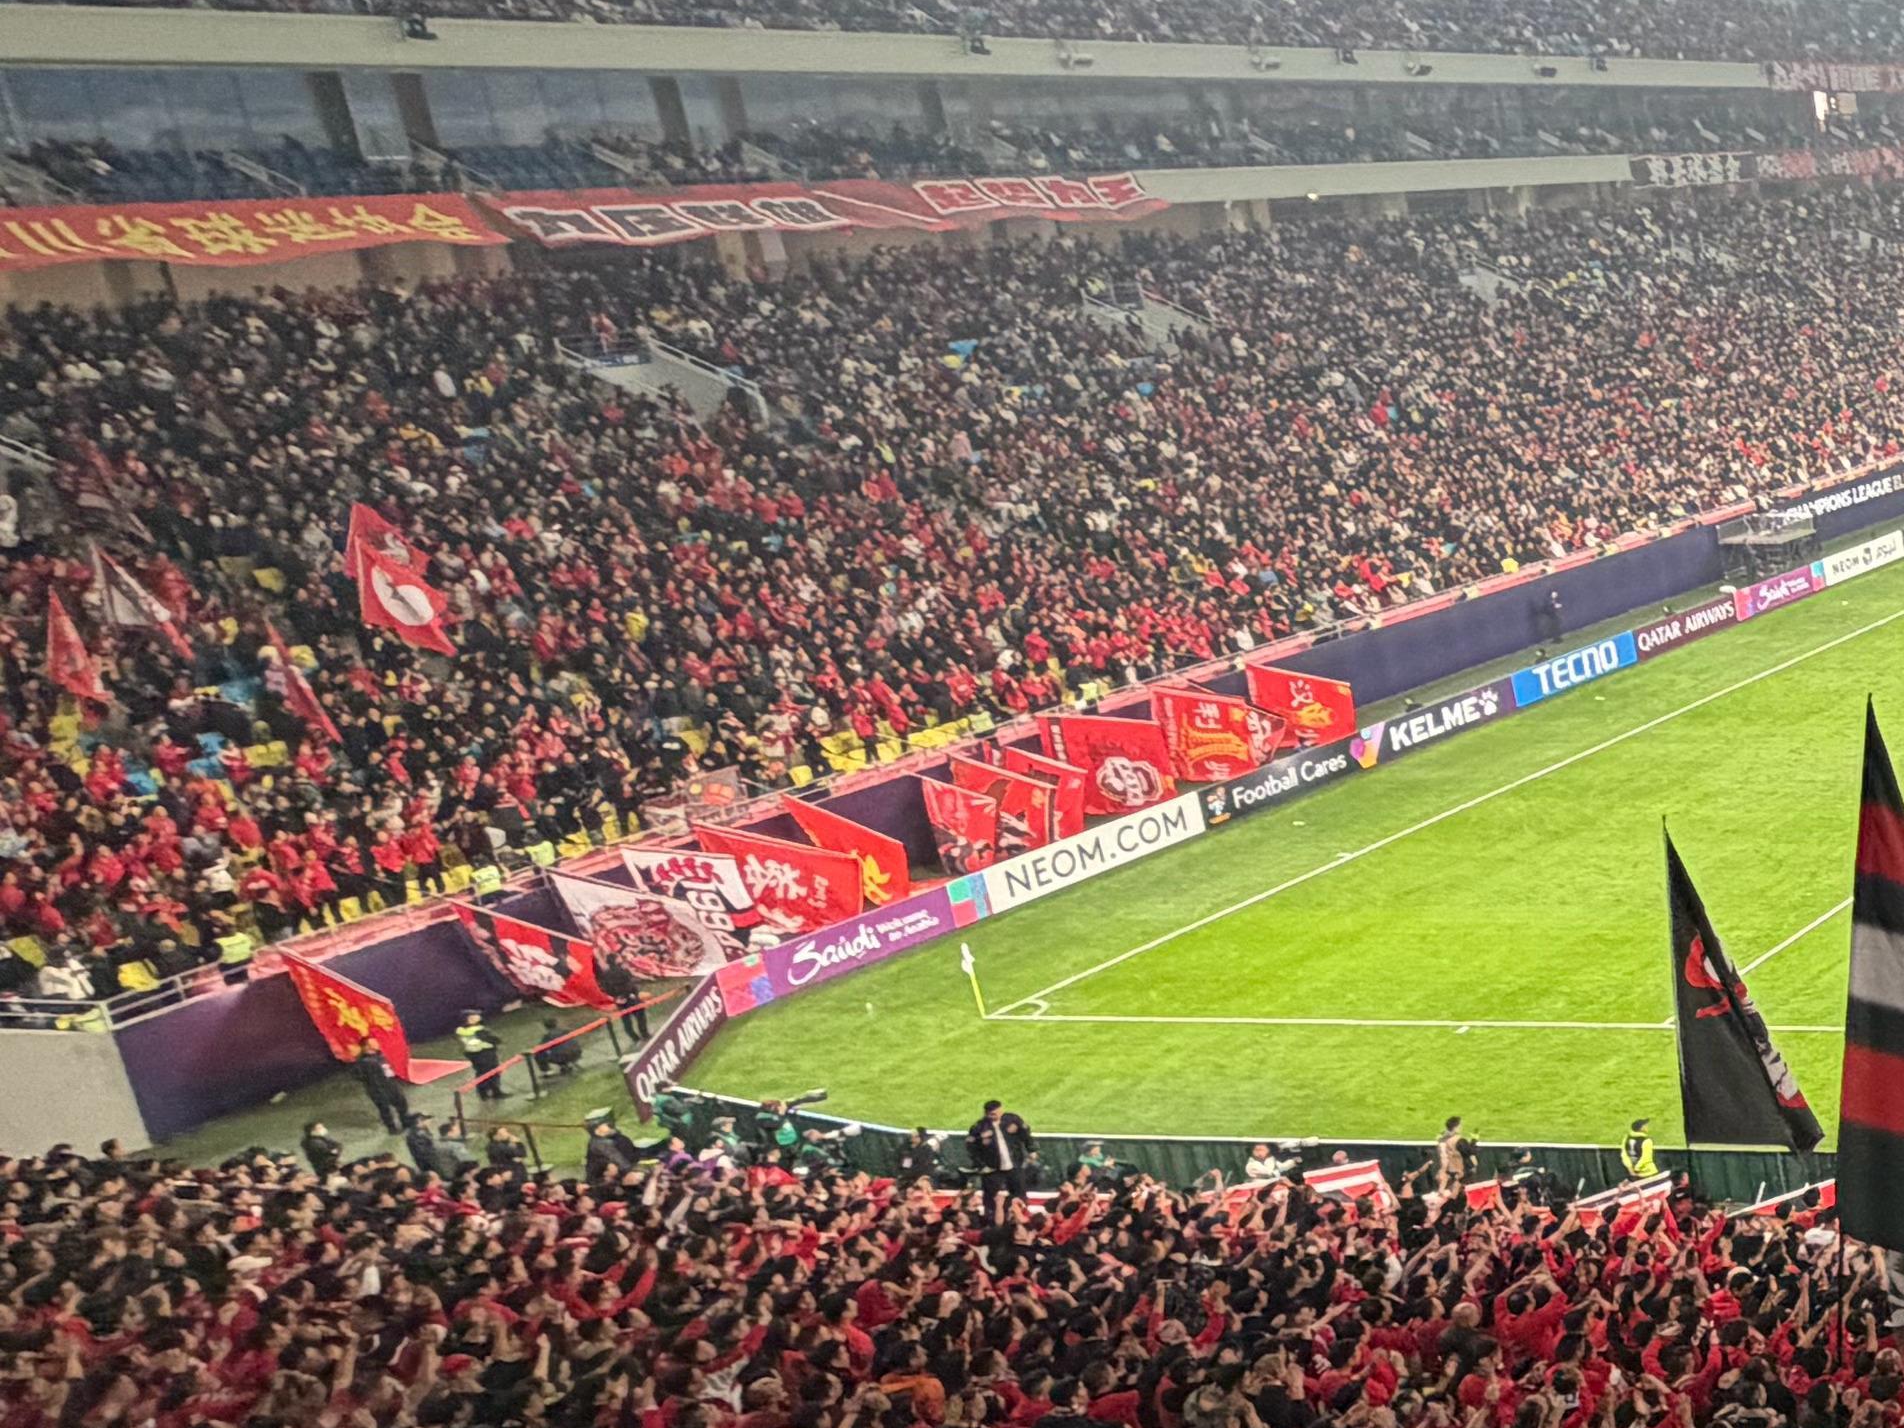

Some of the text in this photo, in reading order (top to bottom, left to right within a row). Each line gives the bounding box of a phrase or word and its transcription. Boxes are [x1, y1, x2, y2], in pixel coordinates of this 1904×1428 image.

[0, 202, 484, 260] 川省球迷协会
[1852, 478, 1893, 504] LEAGUE
[1637, 599, 1735, 653] QATAR AIRWAYS
[1532, 640, 1619, 695] TECNO
[1389, 697, 1482, 751] KELME
[1232, 754, 1348, 810] Football Cares
[1004, 804, 1188, 898] NEOM.COM
[787, 923, 881, 986] Saudi
[636, 985, 723, 1104] QATAR AIRWAYS
